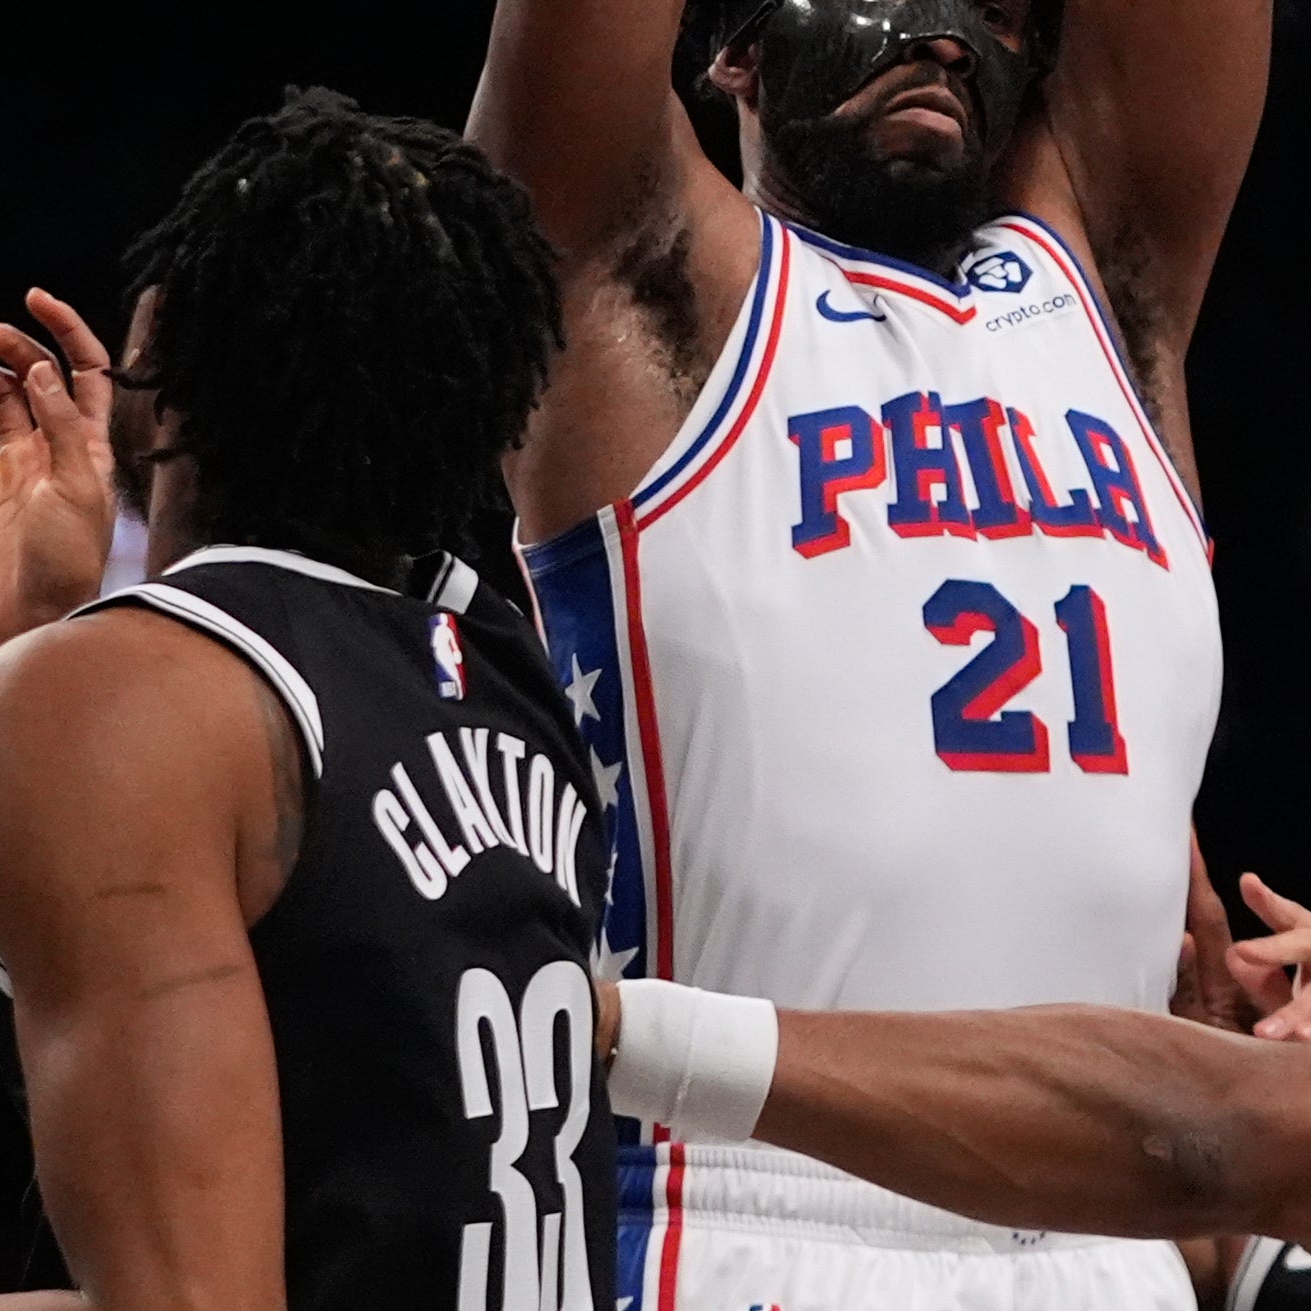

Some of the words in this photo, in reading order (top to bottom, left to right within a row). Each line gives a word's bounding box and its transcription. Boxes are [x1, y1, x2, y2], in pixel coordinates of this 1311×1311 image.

[787, 390, 1170, 571] PHILA
[922, 579, 1129, 775] 21
[372, 726, 587, 909] CLAXTON
[456, 960, 592, 1311] 33
